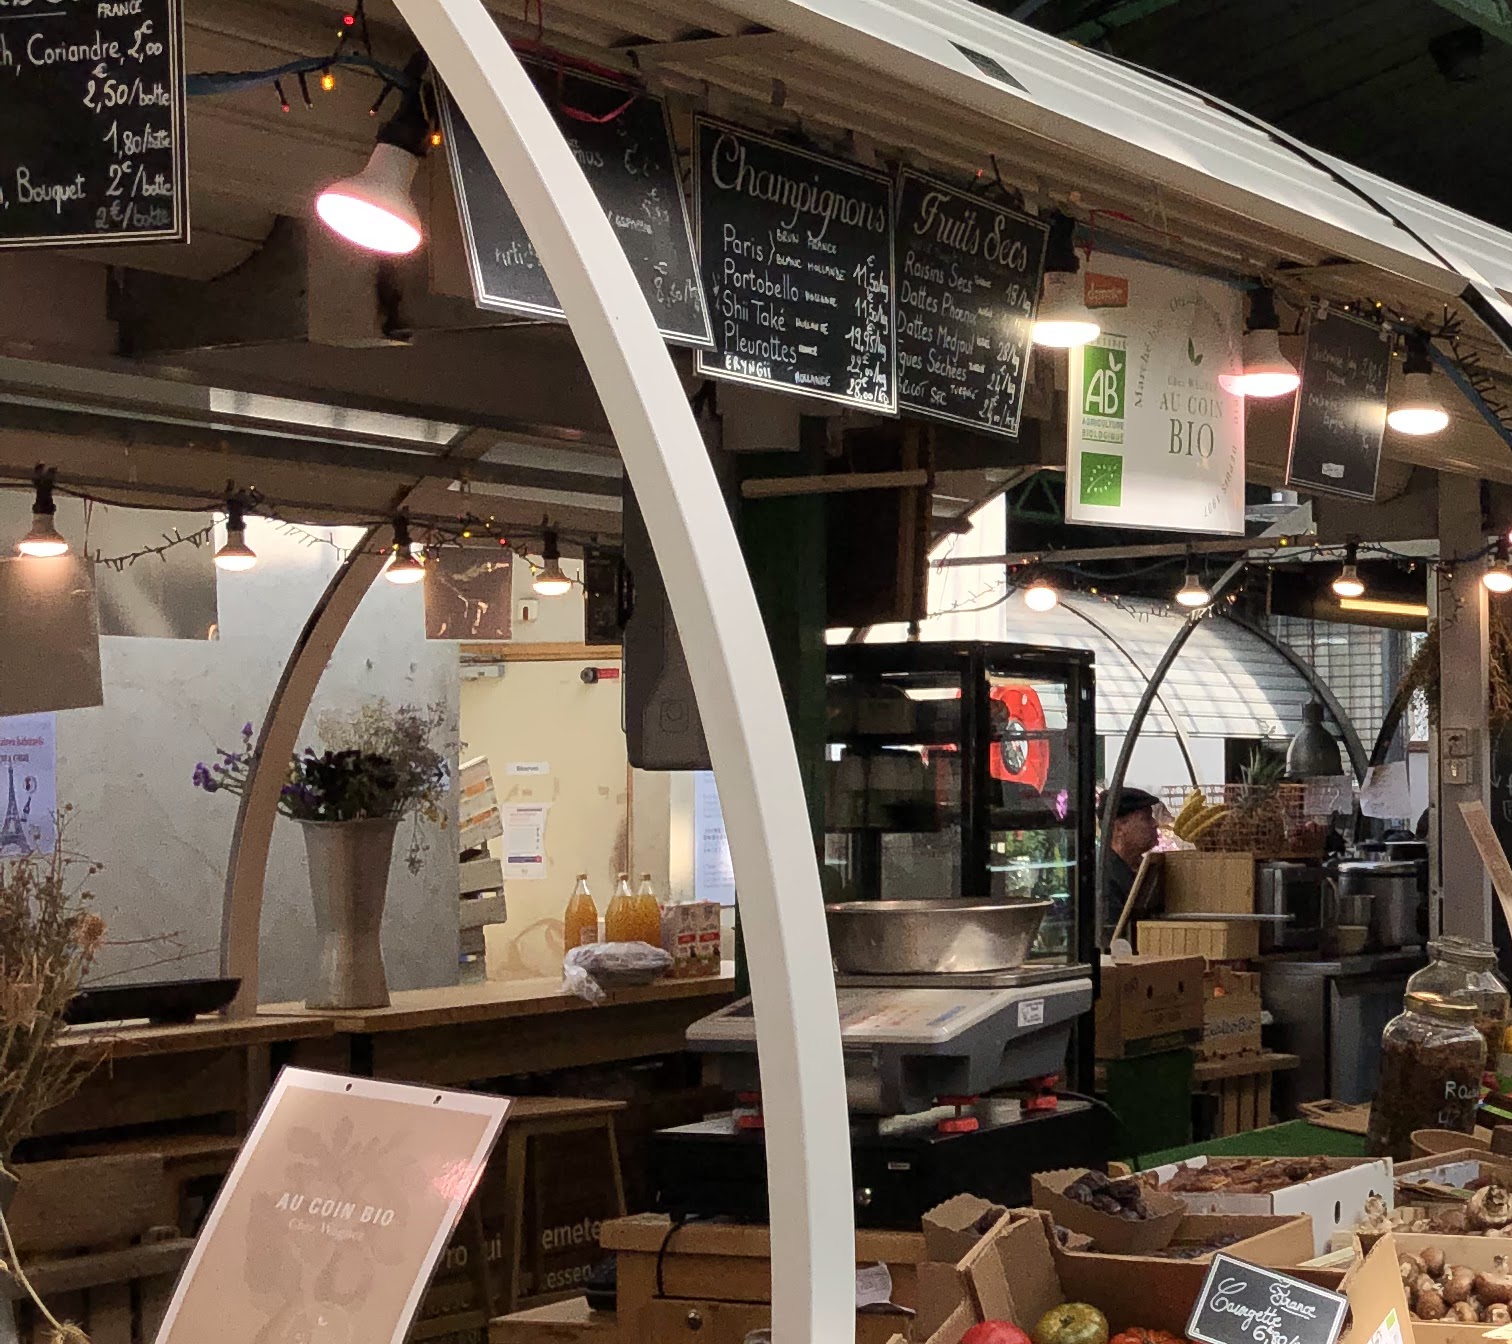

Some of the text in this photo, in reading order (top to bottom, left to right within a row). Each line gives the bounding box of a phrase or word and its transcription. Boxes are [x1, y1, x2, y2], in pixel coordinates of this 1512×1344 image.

[98, 0, 142, 18] FRANCE
[17, 167, 86, 214] Bouquet
[712, 132, 885, 242] Champignons
[724, 223, 763, 262] Paris
[913, 192, 1028, 272] Fruits Secs
[724, 257, 799, 302] Portobello
[904, 250, 945, 285] Raisins
[948, 262, 974, 294] Secs
[722, 289, 749, 322] Shii
[751, 299, 786, 332] Také
[900, 280, 938, 313] Dattes
[724, 320, 797, 363] Pleurottes
[897, 309, 934, 343] Dattes
[1085, 368, 1119, 415] AB
[1159, 392, 1223, 419] AU COIN
[1168, 418, 1215, 459] BIO
[275, 1193, 395, 1228] AU COIN BIO
[1269, 1278, 1317, 1316] France
